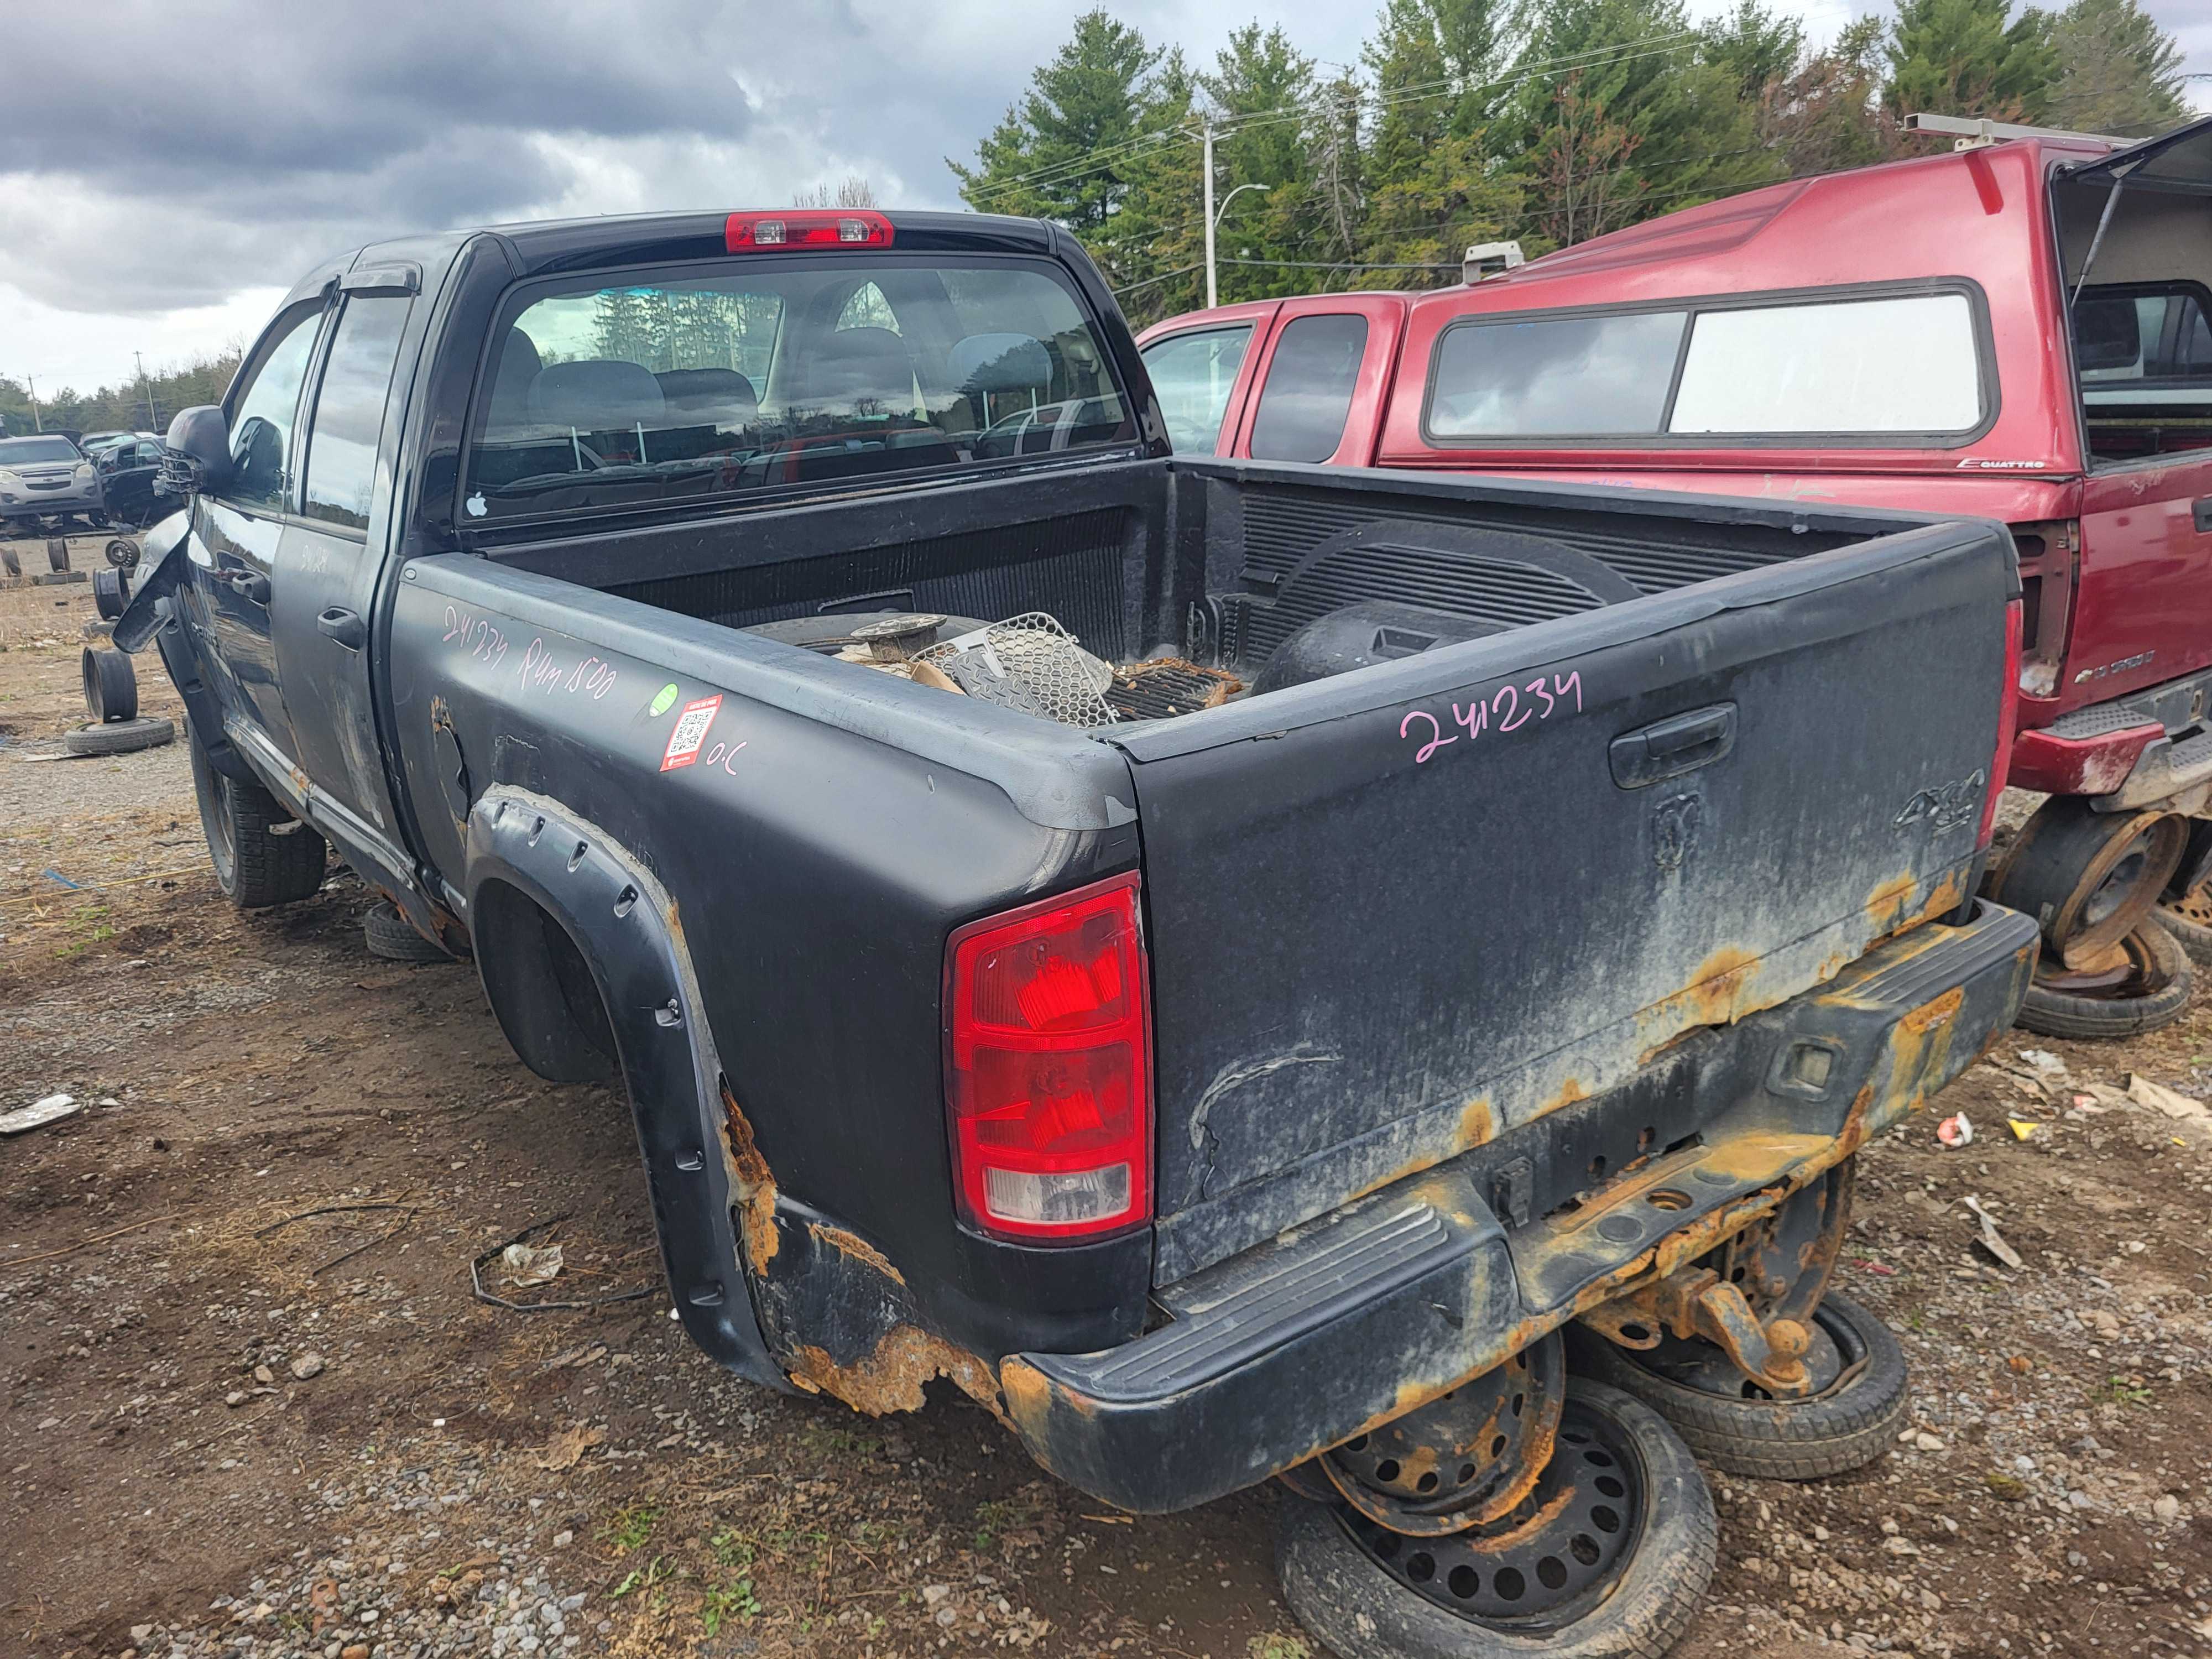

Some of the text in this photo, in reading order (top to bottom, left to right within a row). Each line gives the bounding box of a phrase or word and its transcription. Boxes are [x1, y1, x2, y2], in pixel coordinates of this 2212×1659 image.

[442, 605, 509, 671] 241234
[564, 656, 617, 700] 1500
[1399, 670, 1583, 764] 241234
